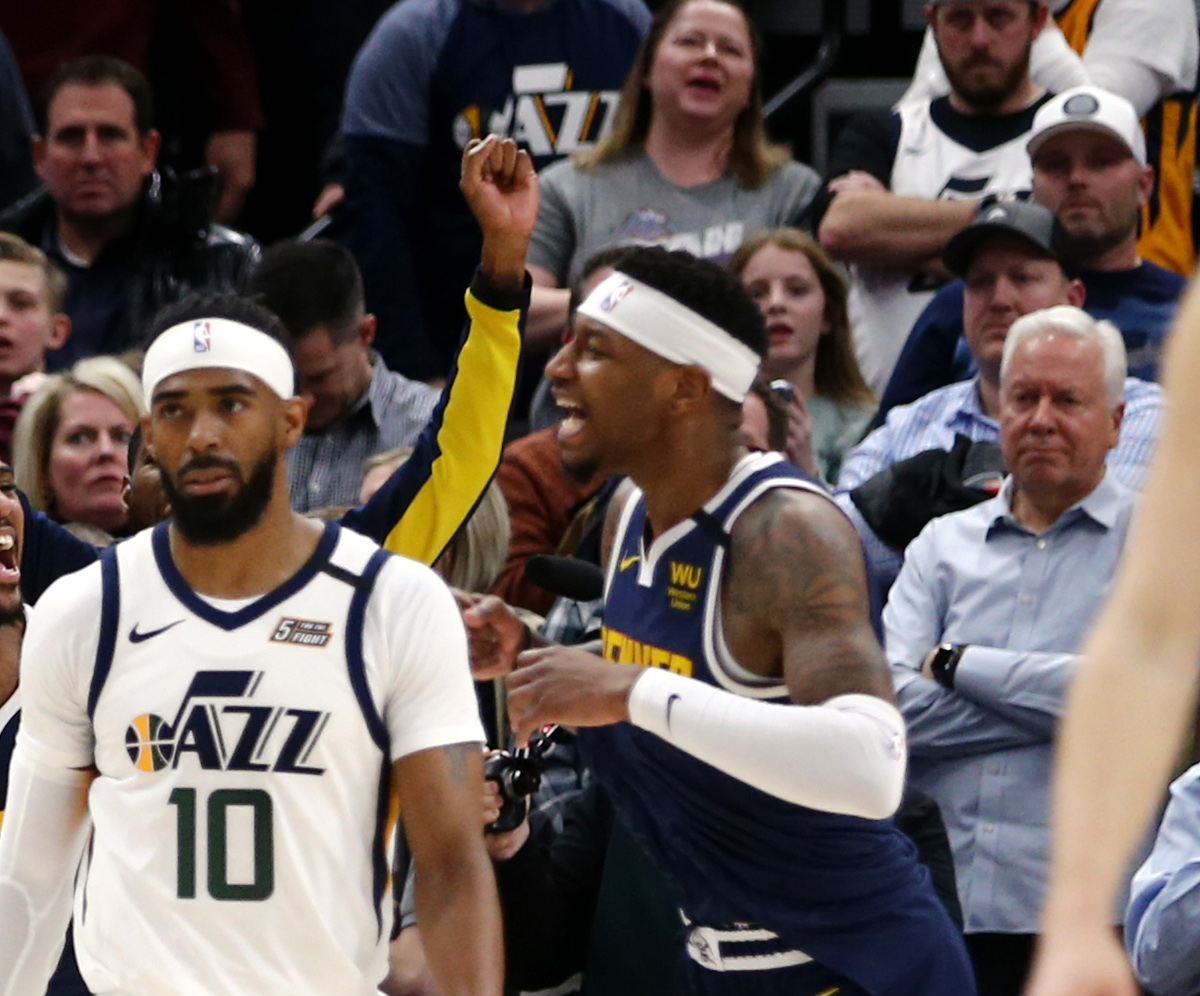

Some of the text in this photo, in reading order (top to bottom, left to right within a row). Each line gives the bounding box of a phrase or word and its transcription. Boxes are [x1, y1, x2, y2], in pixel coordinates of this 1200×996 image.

[671, 561, 702, 589] WU
[275, 620, 295, 640] 5
[292, 632, 329, 645] FIGHT
[125, 670, 332, 776] JAZZ
[167, 787, 275, 901] 10
